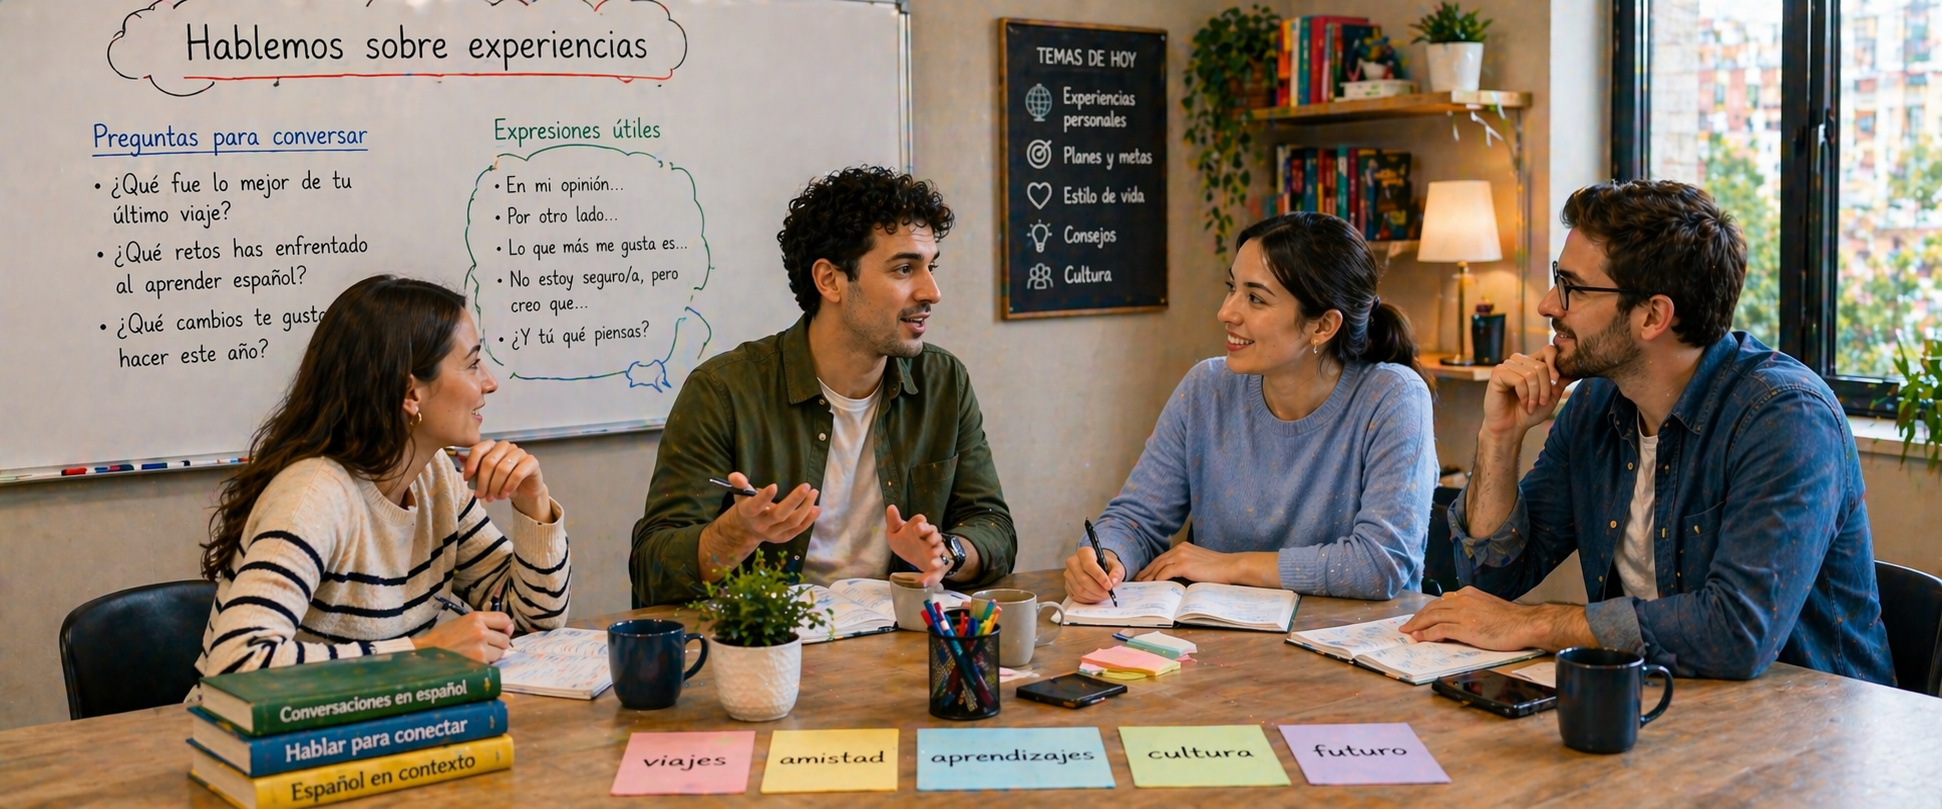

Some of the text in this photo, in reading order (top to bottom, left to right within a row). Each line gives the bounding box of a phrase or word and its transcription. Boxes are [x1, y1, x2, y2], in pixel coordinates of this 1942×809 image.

[186, 24, 647, 72] Hablemos sobre experiencias
[1036, 47, 1137, 68] TEMAS DE HOY
[1063, 87, 1136, 110] Experiencias
[494, 117, 661, 147] Expresiones útiles
[1063, 111, 1127, 133] personales
[93, 124, 368, 156] Preguntas para conversar
[1063, 146, 1153, 171] Planes y metas
[111, 170, 352, 200] ¿Qué fue lo mejor de tu
[506, 176, 526, 194] En
[535, 178, 552, 193] mi
[1063, 186, 1145, 205] Estilo de vida
[113, 201, 232, 230] último viaje?
[507, 207, 531, 225] Por
[539, 208, 568, 224] otro
[1063, 225, 1117, 249] Consejos
[114, 234, 368, 268] ¿Qué retos has enfrentado
[508, 239, 526, 256] Lo
[532, 244, 556, 261] que
[562, 238, 589, 254] más
[596, 242, 615, 252] me
[621, 238, 656, 259] gusta
[116, 265, 307, 300] al aprender español?
[510, 267, 679, 292] No estoy seguro/a, pero
[1064, 266, 1113, 284] Cultura
[510, 301, 541, 313] creo
[116, 313, 164, 340] ¿Qué
[176, 310, 244, 331] cambios
[253, 309, 272, 327] te
[511, 320, 650, 351] ¿Y tú qué piensas?
[119, 339, 269, 368] hacer este año?
[280, 679, 468, 723] Conversaciones en español
[285, 720, 468, 763] Hablar para conectar
[1147, 746, 1254, 760] cultura
[1313, 744, 1408, 758] futuro
[643, 754, 727, 771] viajes
[779, 751, 885, 766] amistad
[931, 748, 1096, 767] aprendizajes
[291, 754, 476, 802] Español en contexto
